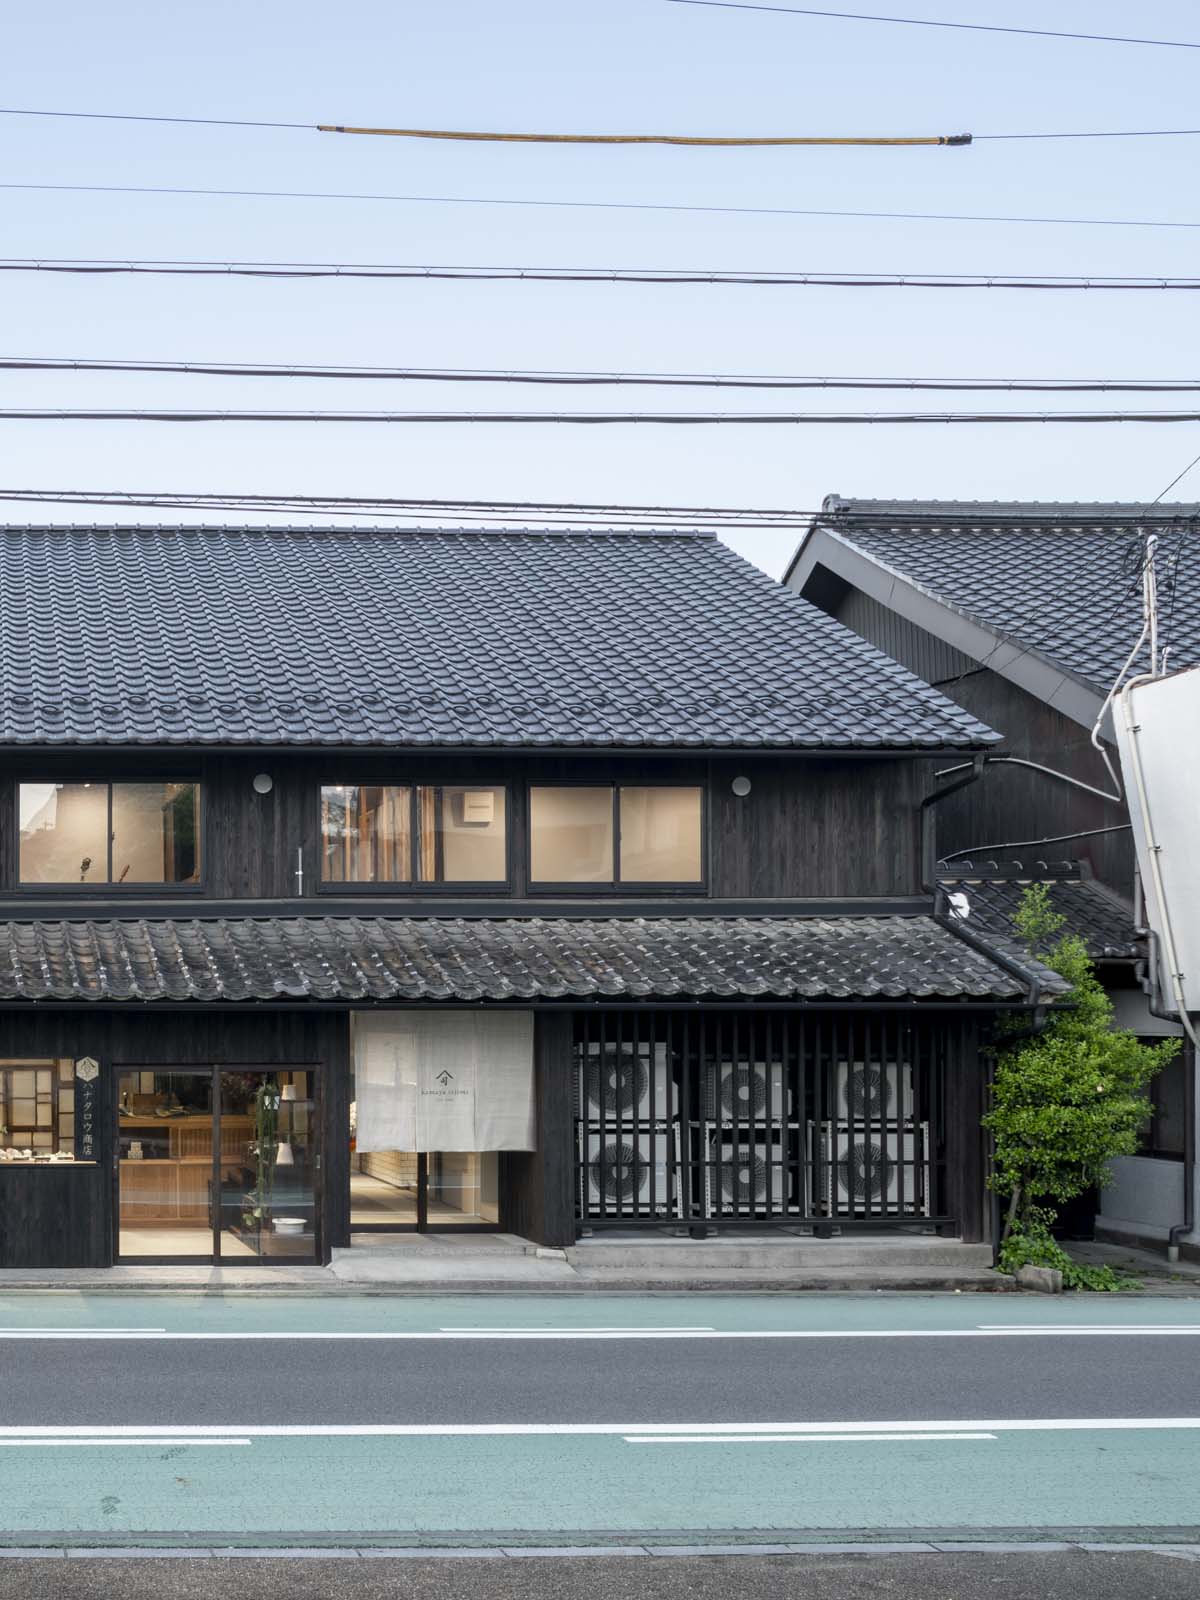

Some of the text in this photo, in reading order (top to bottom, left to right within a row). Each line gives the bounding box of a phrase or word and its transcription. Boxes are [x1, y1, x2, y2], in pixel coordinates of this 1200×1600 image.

[83, 1082, 93, 1155] ハナタロウ商店
